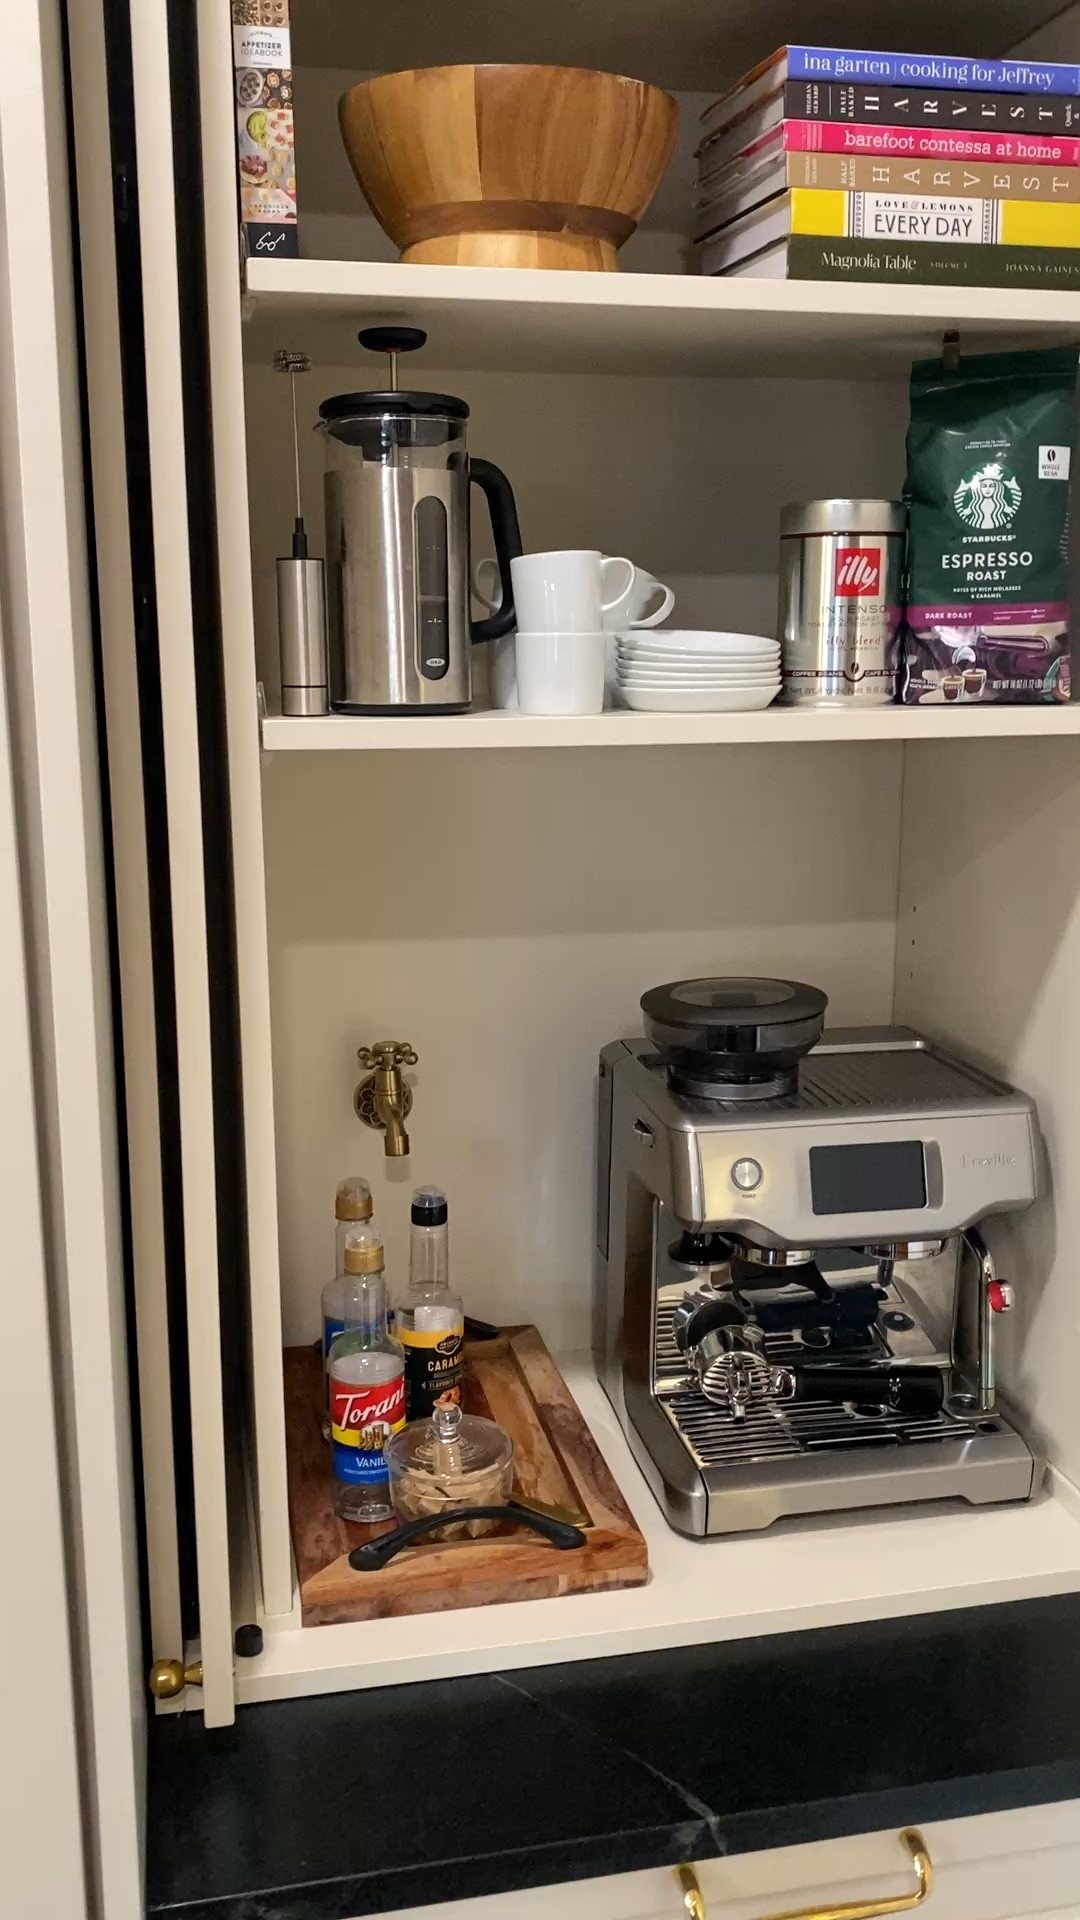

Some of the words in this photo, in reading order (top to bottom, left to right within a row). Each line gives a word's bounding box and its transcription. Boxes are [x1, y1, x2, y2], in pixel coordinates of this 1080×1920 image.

[241, 41, 282, 49] APPETIZER
[803, 53, 831, 71] ina
[834, 57, 890, 76] garten
[900, 61, 969, 84] cooking
[971, 63, 996, 82] for
[998, 67, 1055, 90] Jeffrey
[864, 97, 1053, 121] HARVEST
[844, 130, 915, 150] barefoot
[919, 138, 992, 155] contessa
[995, 142, 1013, 156] at
[1016, 141, 1061, 159] home
[872, 166, 1069, 192] HARVEST
[875, 200, 909, 209] LOVE
[922, 202, 973, 212] LEMONS
[874, 214, 931, 235] EVERY
[936, 217, 972, 237] DAY
[820, 252, 880, 270] Magnolia
[883, 254, 917, 270] Table
[1006, 263, 1042, 273] JOANNA
[1045, 265, 1080, 274] GAINES
[942, 551, 1033, 569] ESPRESSO
[837, 555, 878, 592] illy
[966, 570, 1007, 581] ROAST
